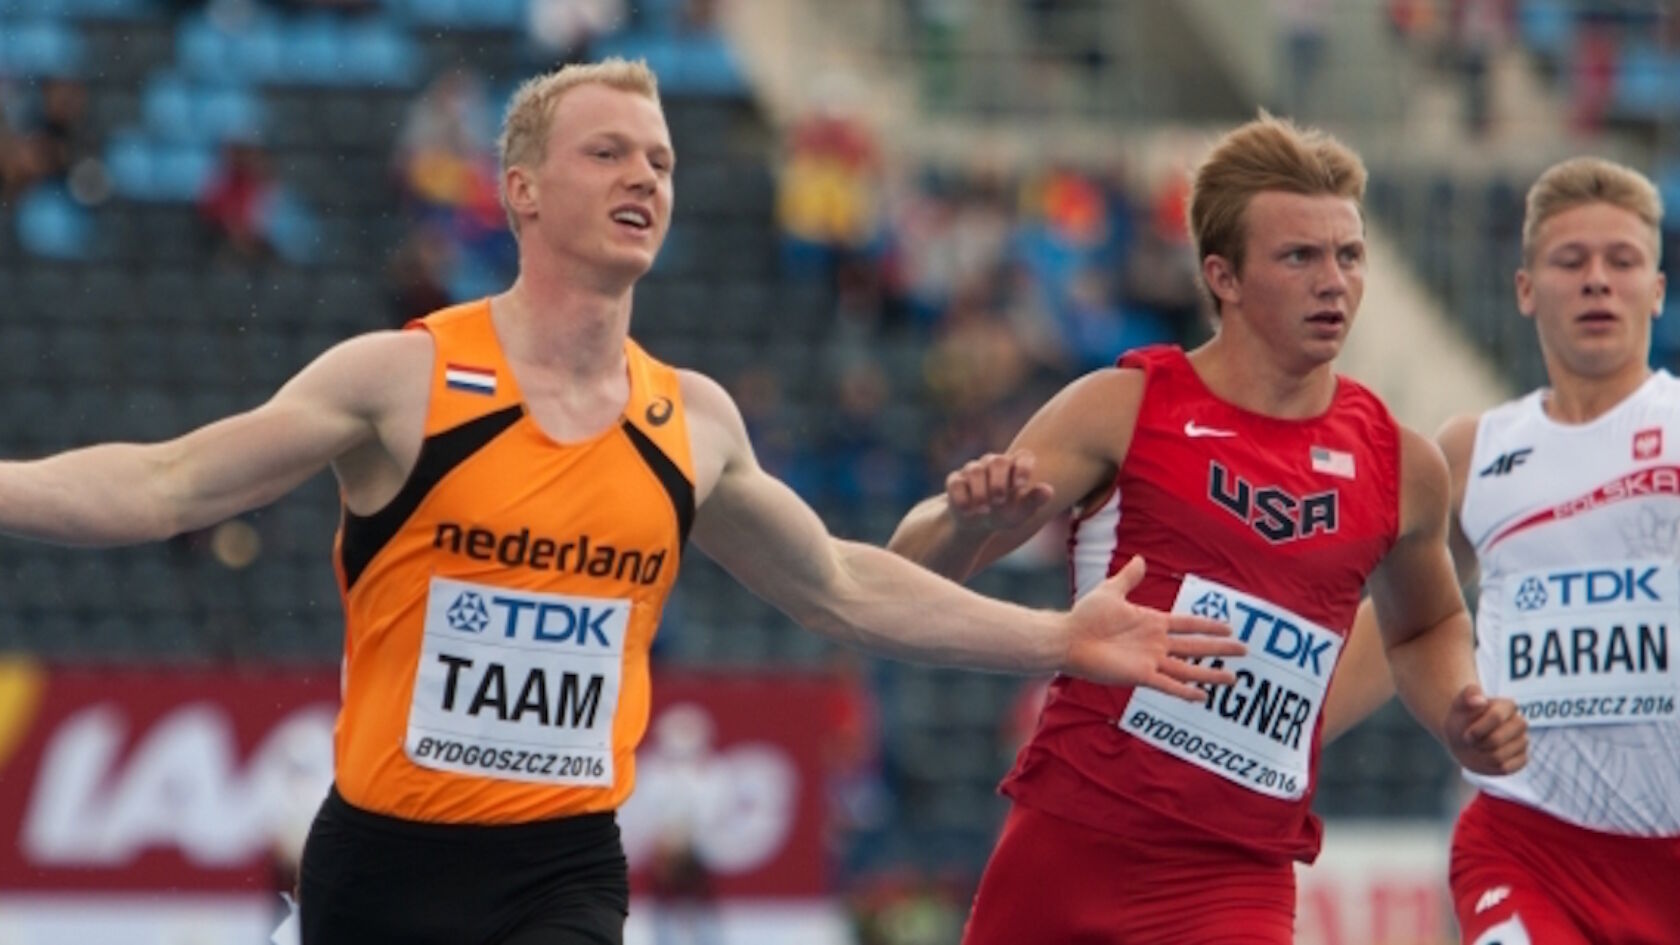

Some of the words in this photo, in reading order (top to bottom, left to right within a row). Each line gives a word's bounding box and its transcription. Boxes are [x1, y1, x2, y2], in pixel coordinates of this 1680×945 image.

[1207, 459, 1339, 544] USA
[432, 521, 666, 586] nederland
[1548, 567, 1662, 607] TDK
[491, 596, 615, 647] TDK
[1235, 601, 1333, 677] TDK
[1508, 624, 1669, 682] BARAN
[437, 653, 604, 730] TAAM
[1188, 656, 1311, 751] AGNER
[1516, 697, 1628, 720] YDGOSZCZ
[1630, 695, 1676, 716] 2016
[414, 736, 558, 776] BYDGOSZCZ
[558, 756, 604, 778] 2016
[1128, 710, 1257, 778] BYDGOSZCZ
[1254, 766, 1297, 794] 2016
